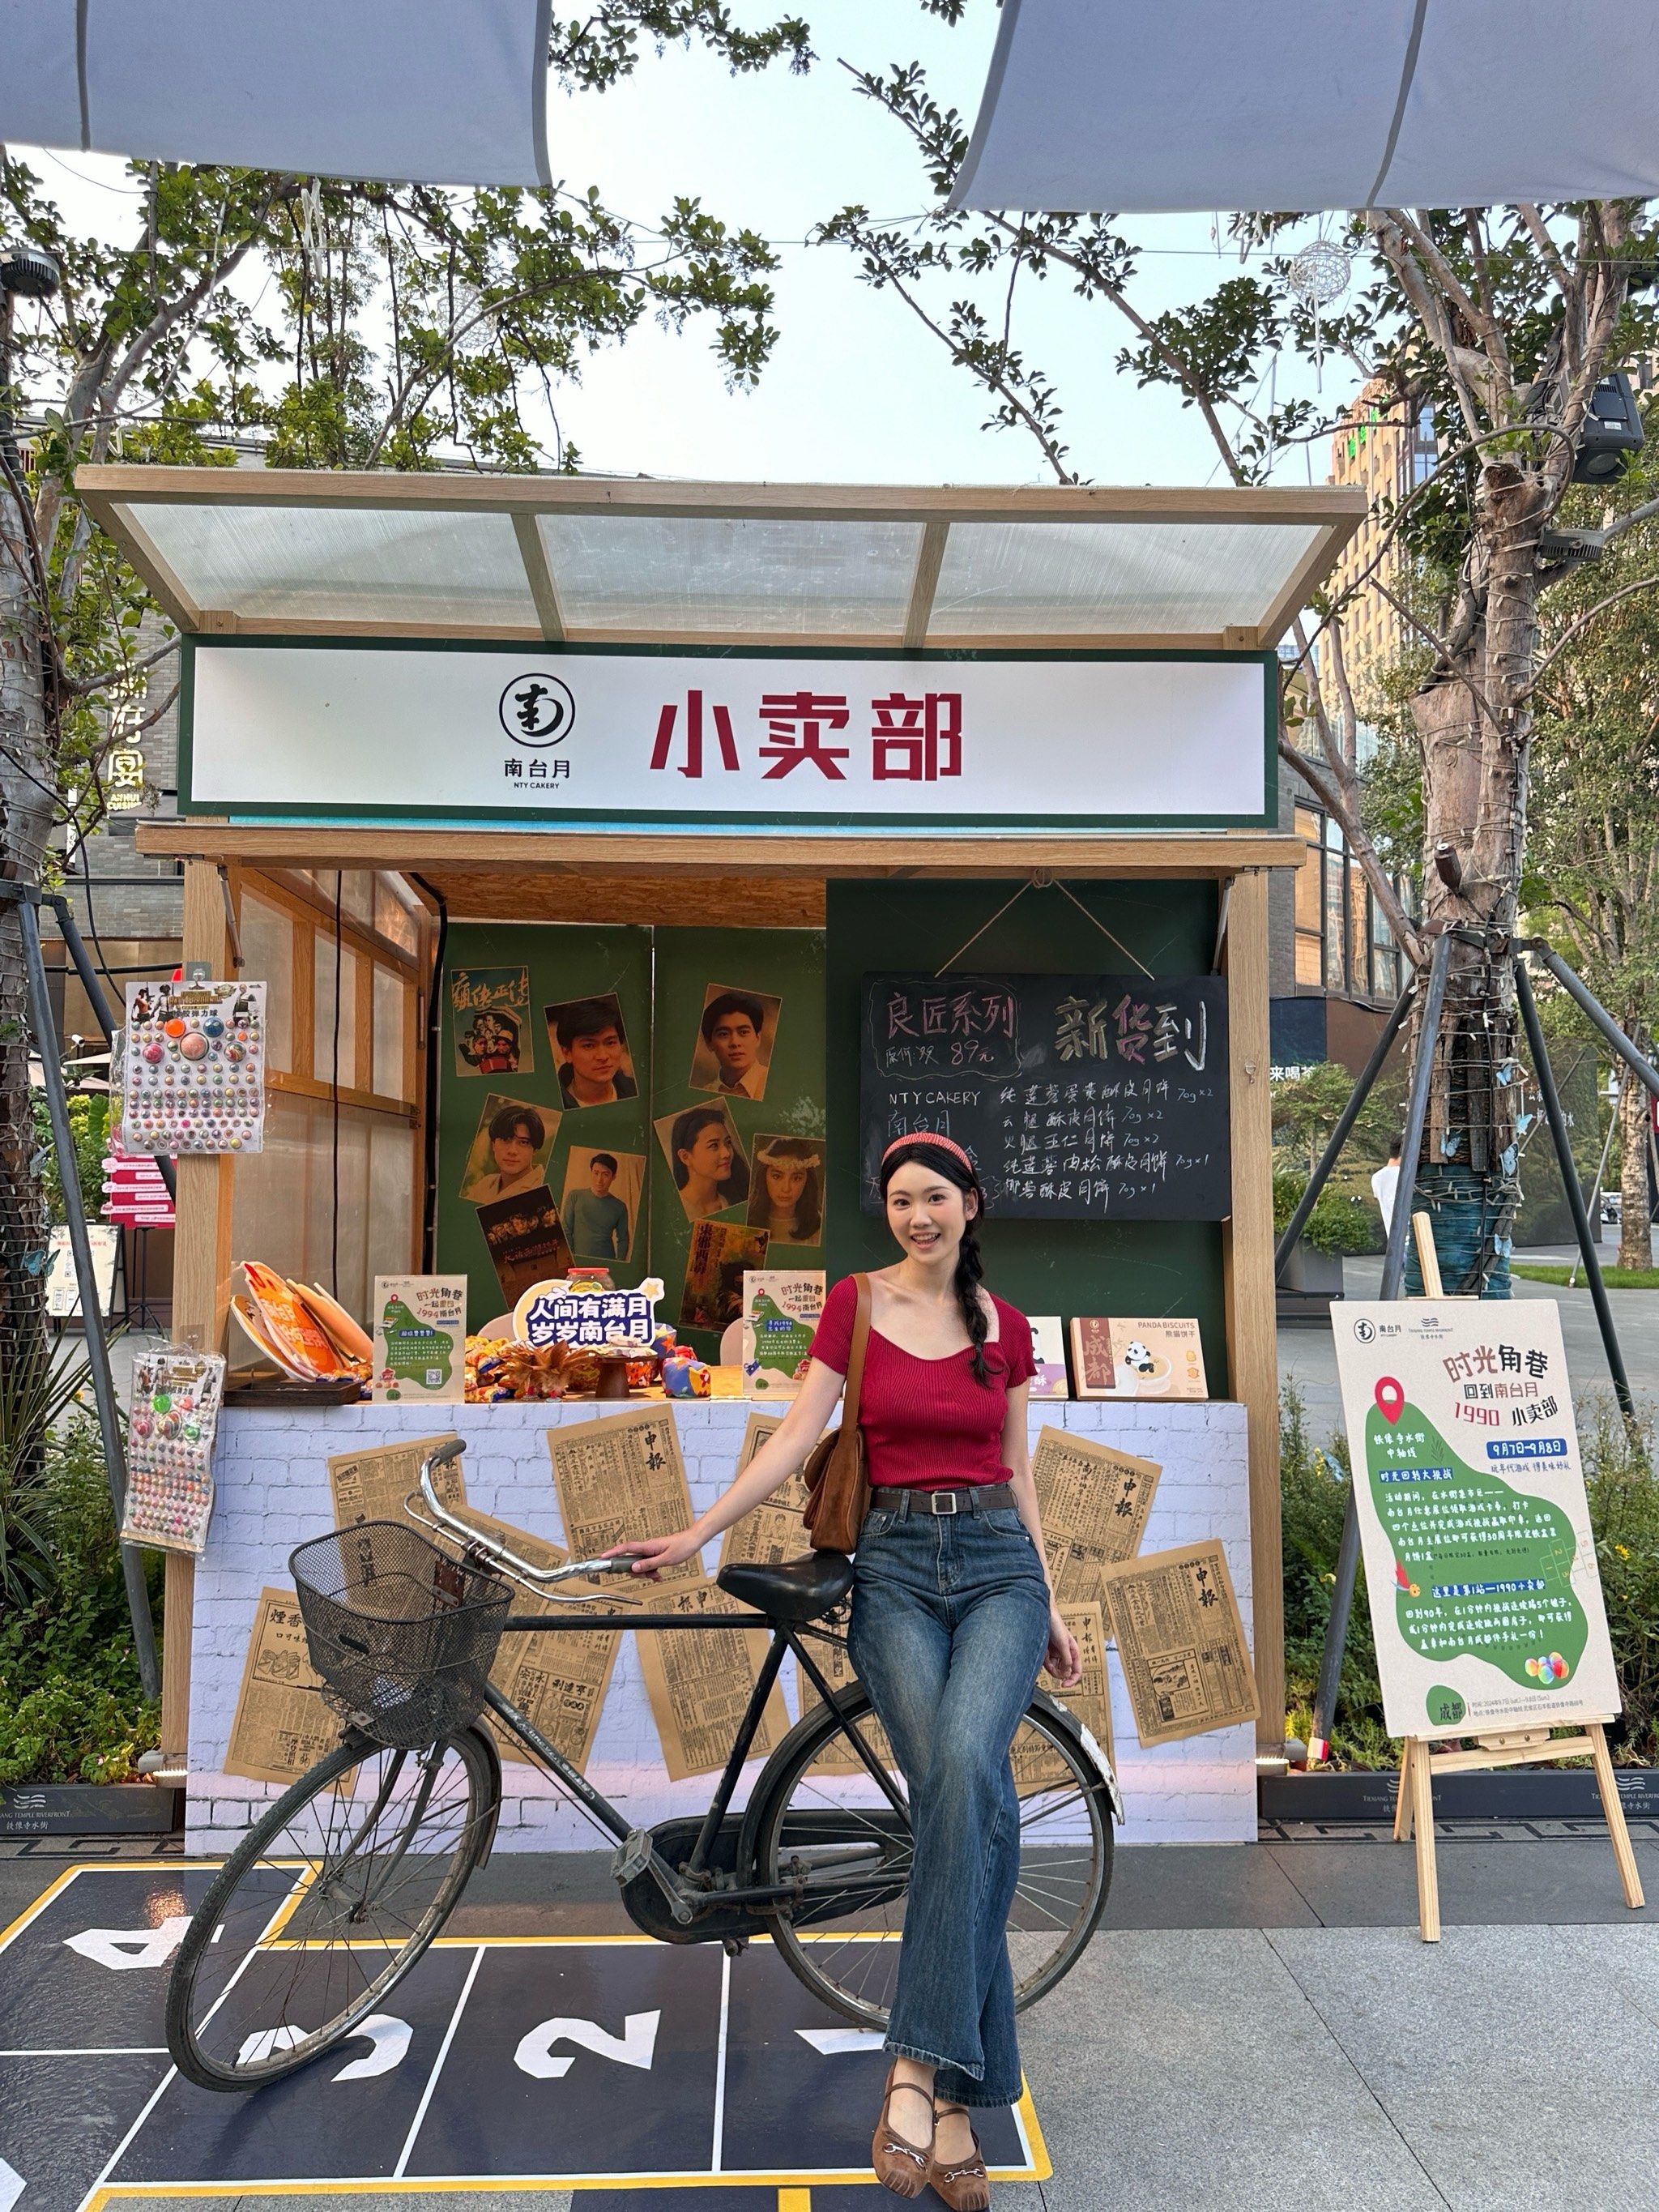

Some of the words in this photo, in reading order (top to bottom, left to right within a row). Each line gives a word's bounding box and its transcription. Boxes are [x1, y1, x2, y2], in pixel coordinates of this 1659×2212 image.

[650, 690, 962, 781] 小卖部
[505, 758, 570, 779] 南台月
[887, 991, 1013, 1040] 良匠系列
[1055, 994, 1207, 1071] 新货到
[889, 1091, 919, 1105] NTY
[925, 1091, 981, 1106] CAKERY
[888, 1110, 951, 1138] 南台月
[416, 1287, 463, 1301] 时光角巷
[781, 1283, 823, 1296] 时光角巷
[529, 1296, 648, 1320] 人间有满月
[531, 1318, 648, 1344] 岁岁南台月
[1379, 1325, 1401, 1333] 南台月
[1084, 1335, 1111, 1385] 成都
[1442, 1344, 1549, 1383] 时光角巷
[1464, 1381, 1538, 1399] 回到南台月
[1455, 1403, 1499, 1426] 1990
[1512, 1395, 1559, 1427] 小卖部
[1374, 1433, 1425, 1445] 铁像寺水街
[1386, 1446, 1418, 1458] 中轴线
[1380, 1467, 1453, 1482] 时光回转大挑战
[1439, 1702, 1463, 1721] 成都
[513, 2010, 660, 2079] 2
